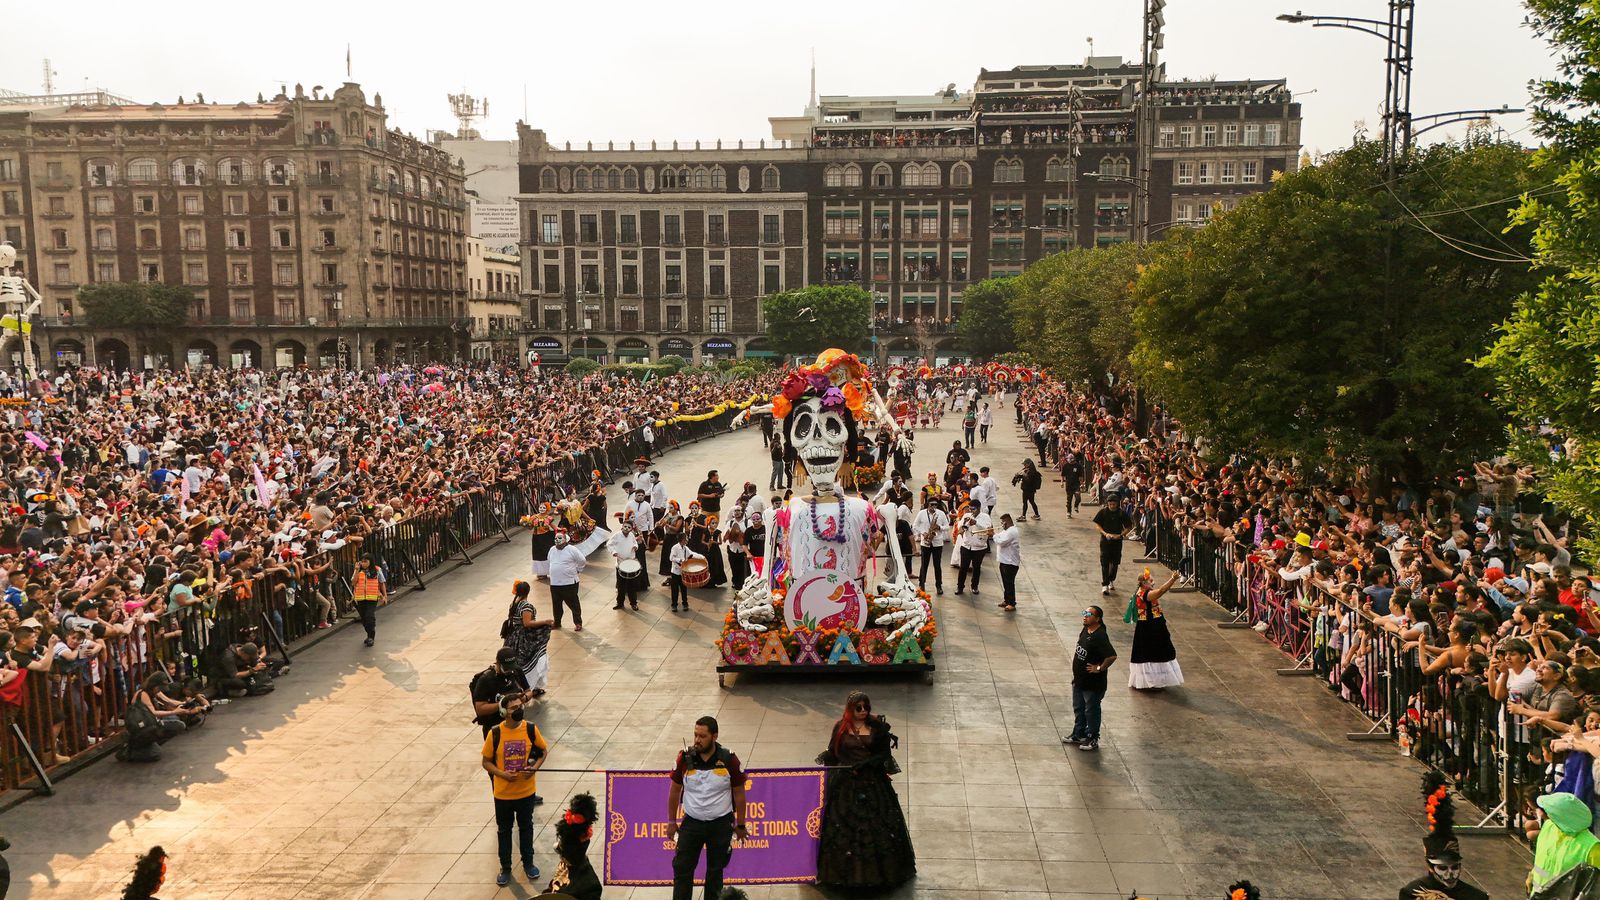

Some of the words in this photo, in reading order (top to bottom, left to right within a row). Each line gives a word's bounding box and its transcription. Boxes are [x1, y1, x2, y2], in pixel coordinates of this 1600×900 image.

[723, 629, 927, 665] OAXACA
[634, 822, 649, 838] LA
[651, 822, 669, 838] FIE
[762, 820, 799, 836] TODAS
